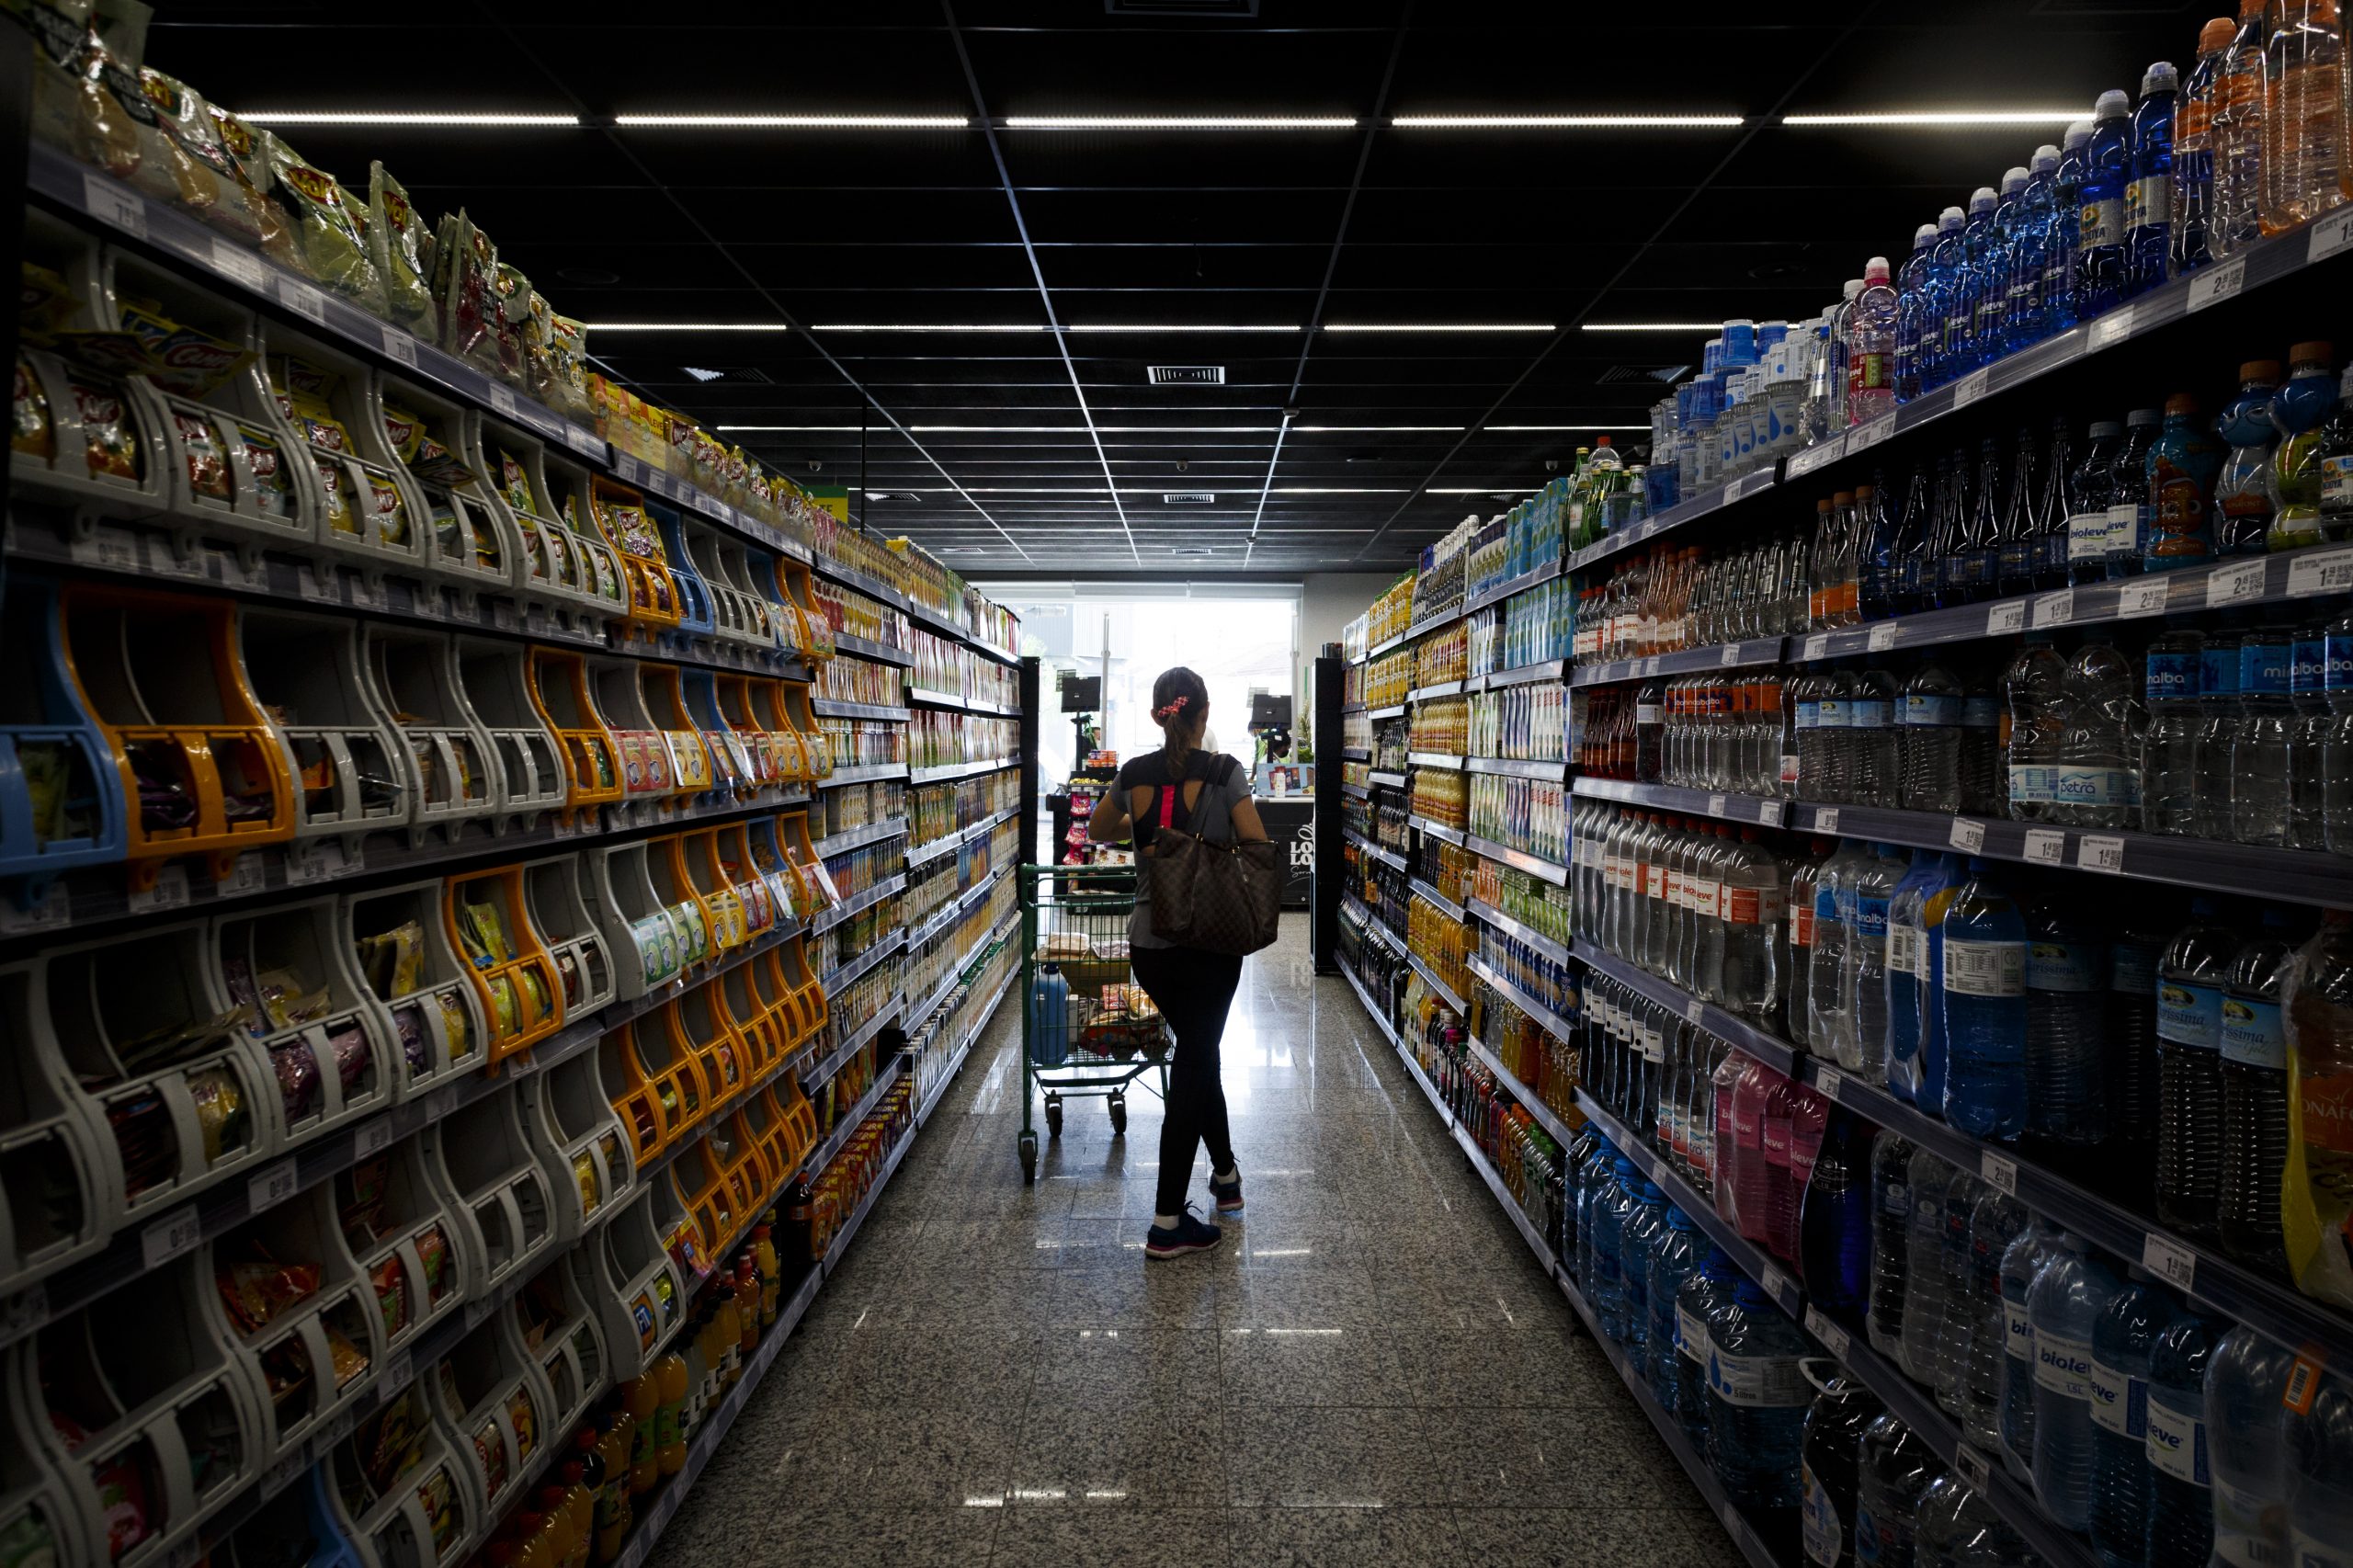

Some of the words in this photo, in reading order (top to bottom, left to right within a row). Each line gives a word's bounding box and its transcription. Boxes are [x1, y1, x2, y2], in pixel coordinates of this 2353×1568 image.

[2108, 520, 2128, 530] leve
[2294, 661, 2325, 675] alba
[2327, 657, 2353, 672] lba
[2147, 672, 2185, 684] nalba
[2060, 782, 2096, 796] petra
[2011, 1319, 2027, 1336] bi
[2091, 1381, 2116, 1403] eve
